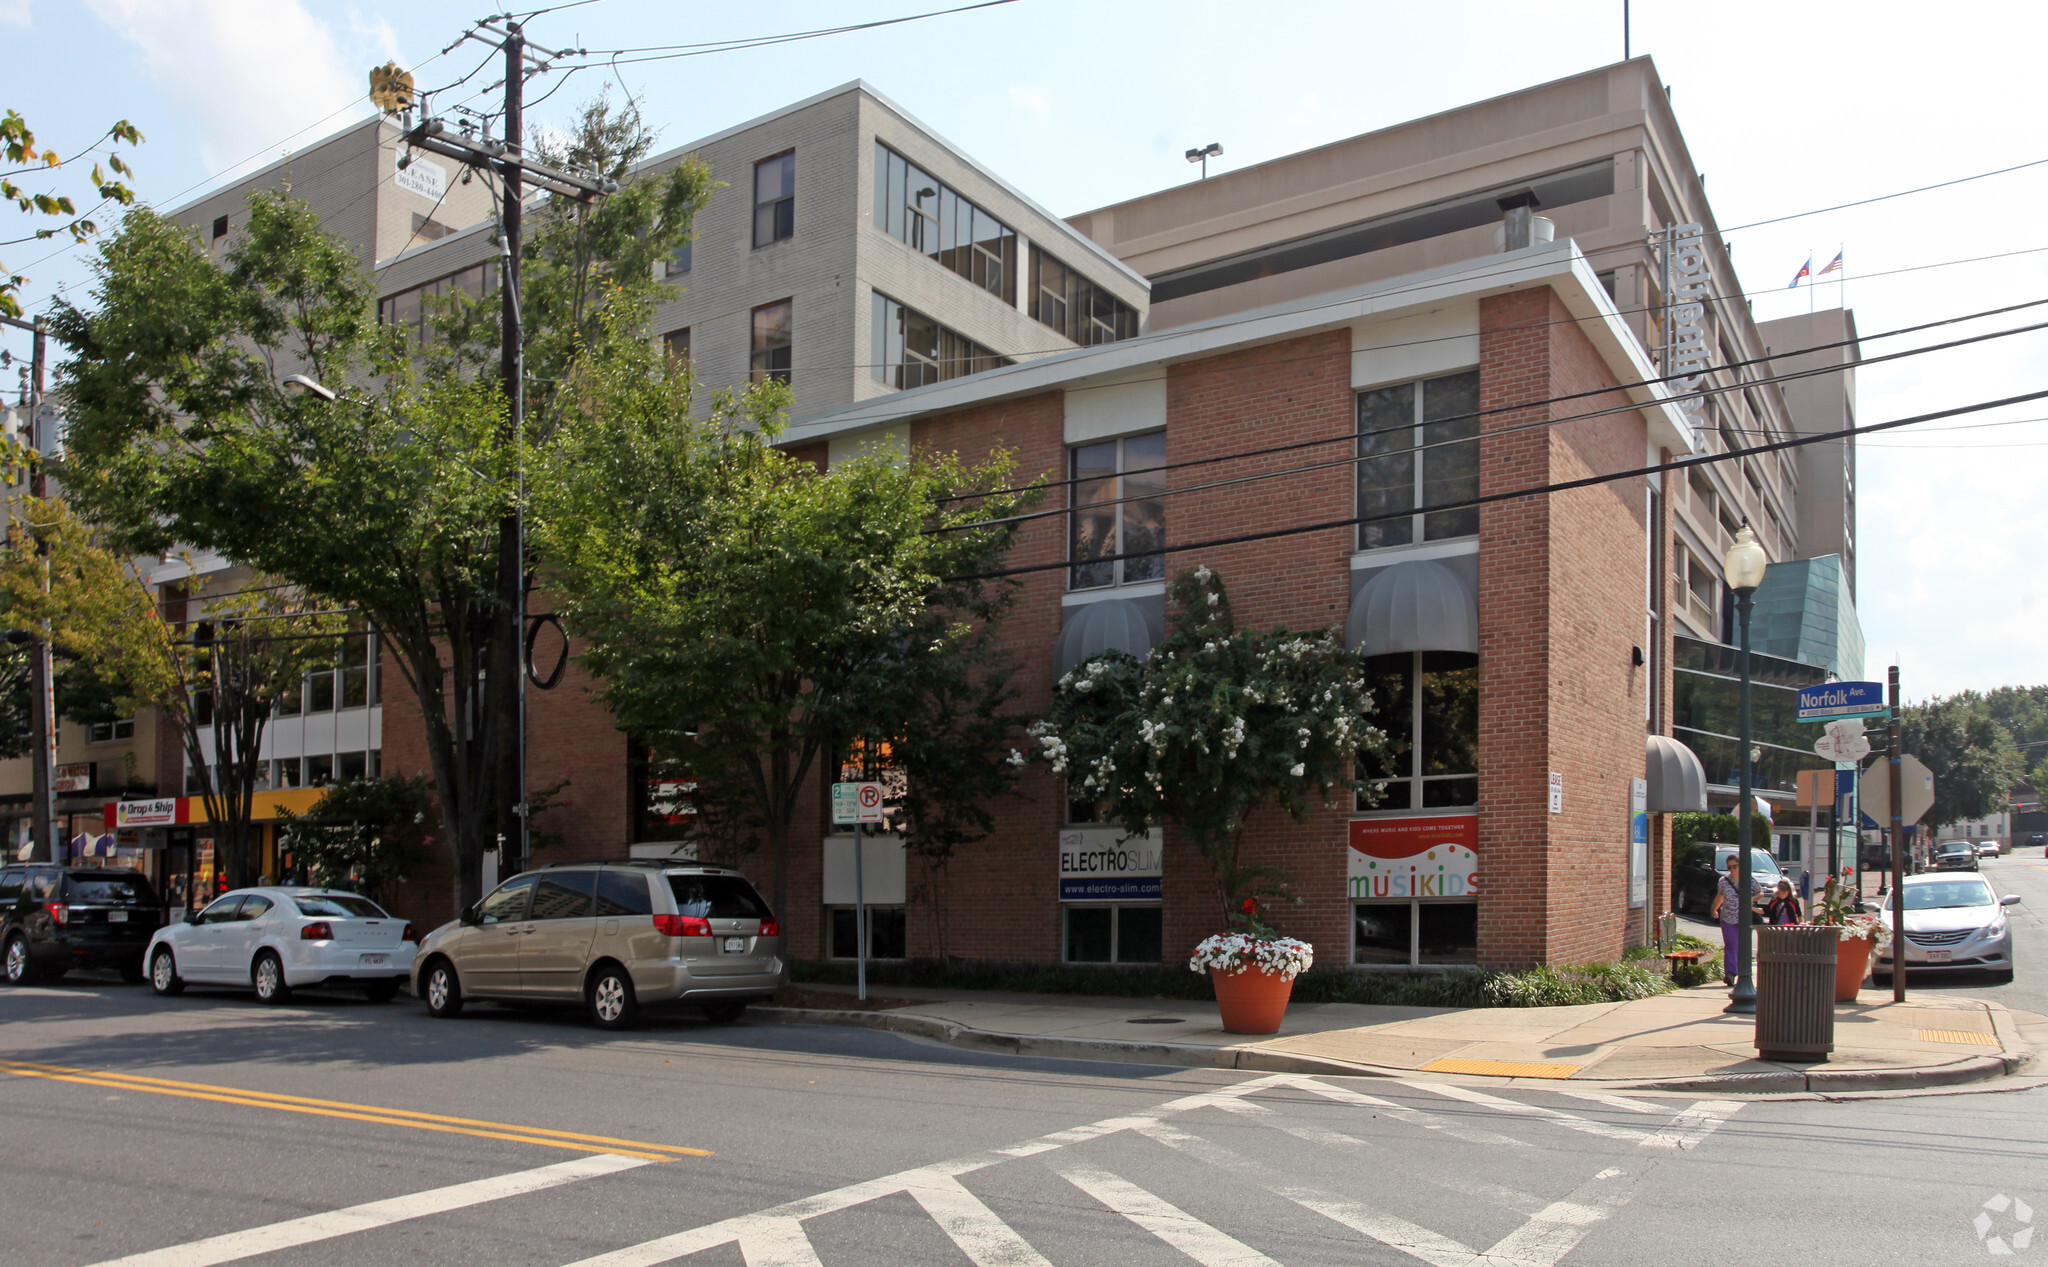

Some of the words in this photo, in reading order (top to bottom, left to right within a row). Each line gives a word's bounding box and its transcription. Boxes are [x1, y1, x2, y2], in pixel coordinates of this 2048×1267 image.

[1801, 690, 1848, 708] Norfolk
[1849, 688, 1866, 697] Ave.
[834, 786, 840, 797] 2
[128, 803, 148, 816] Drop
[148, 804, 153, 812] &
[154, 801, 174, 815] Ship
[1062, 850, 1162, 872] ELECTROSLIM
[1064, 883, 1160, 894] www.electro-slim.com
